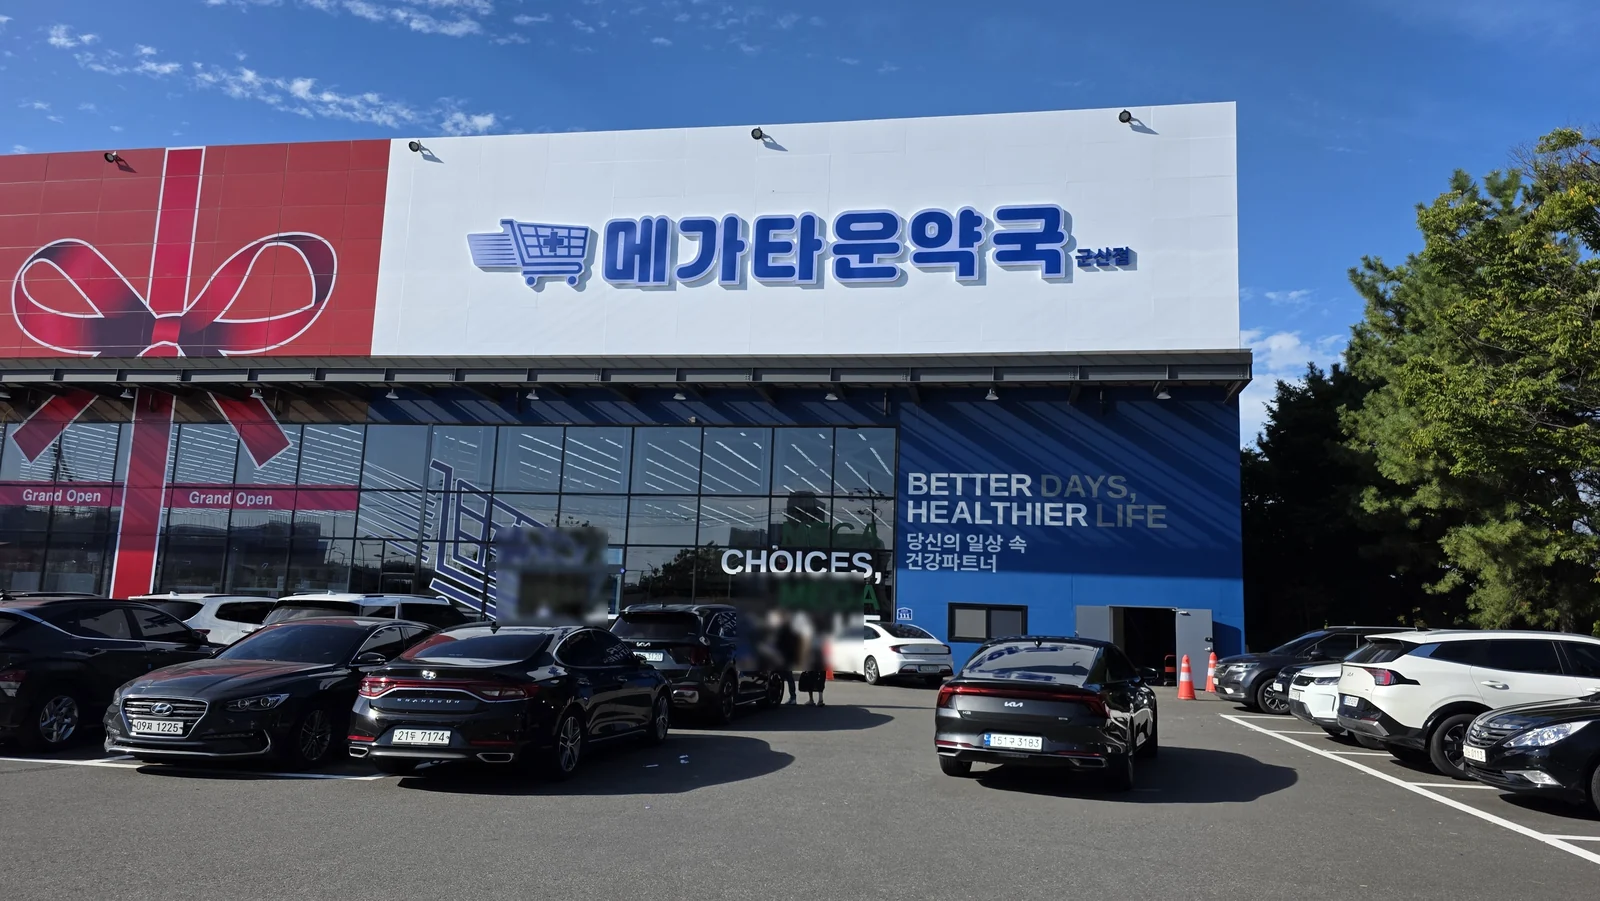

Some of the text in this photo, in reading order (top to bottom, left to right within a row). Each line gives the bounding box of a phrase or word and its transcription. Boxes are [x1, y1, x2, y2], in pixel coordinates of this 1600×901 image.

[602, 203, 1129, 285] 메가타운약국 군산점
[22, 488, 101, 503] Grand Open
[907, 472, 1137, 503] BETTER DAYS,
[189, 491, 273, 506] Grand Open
[906, 500, 1169, 529] HEALTHIER LIFE
[906, 532, 1028, 554] 당신의 일상 속
[720, 549, 882, 584] CHOICES,
[905, 552, 998, 573] 건강파트너
[157, 723, 179, 733] 1225
[420, 731, 445, 742] 7174
[1017, 738, 1040, 748] 3183
